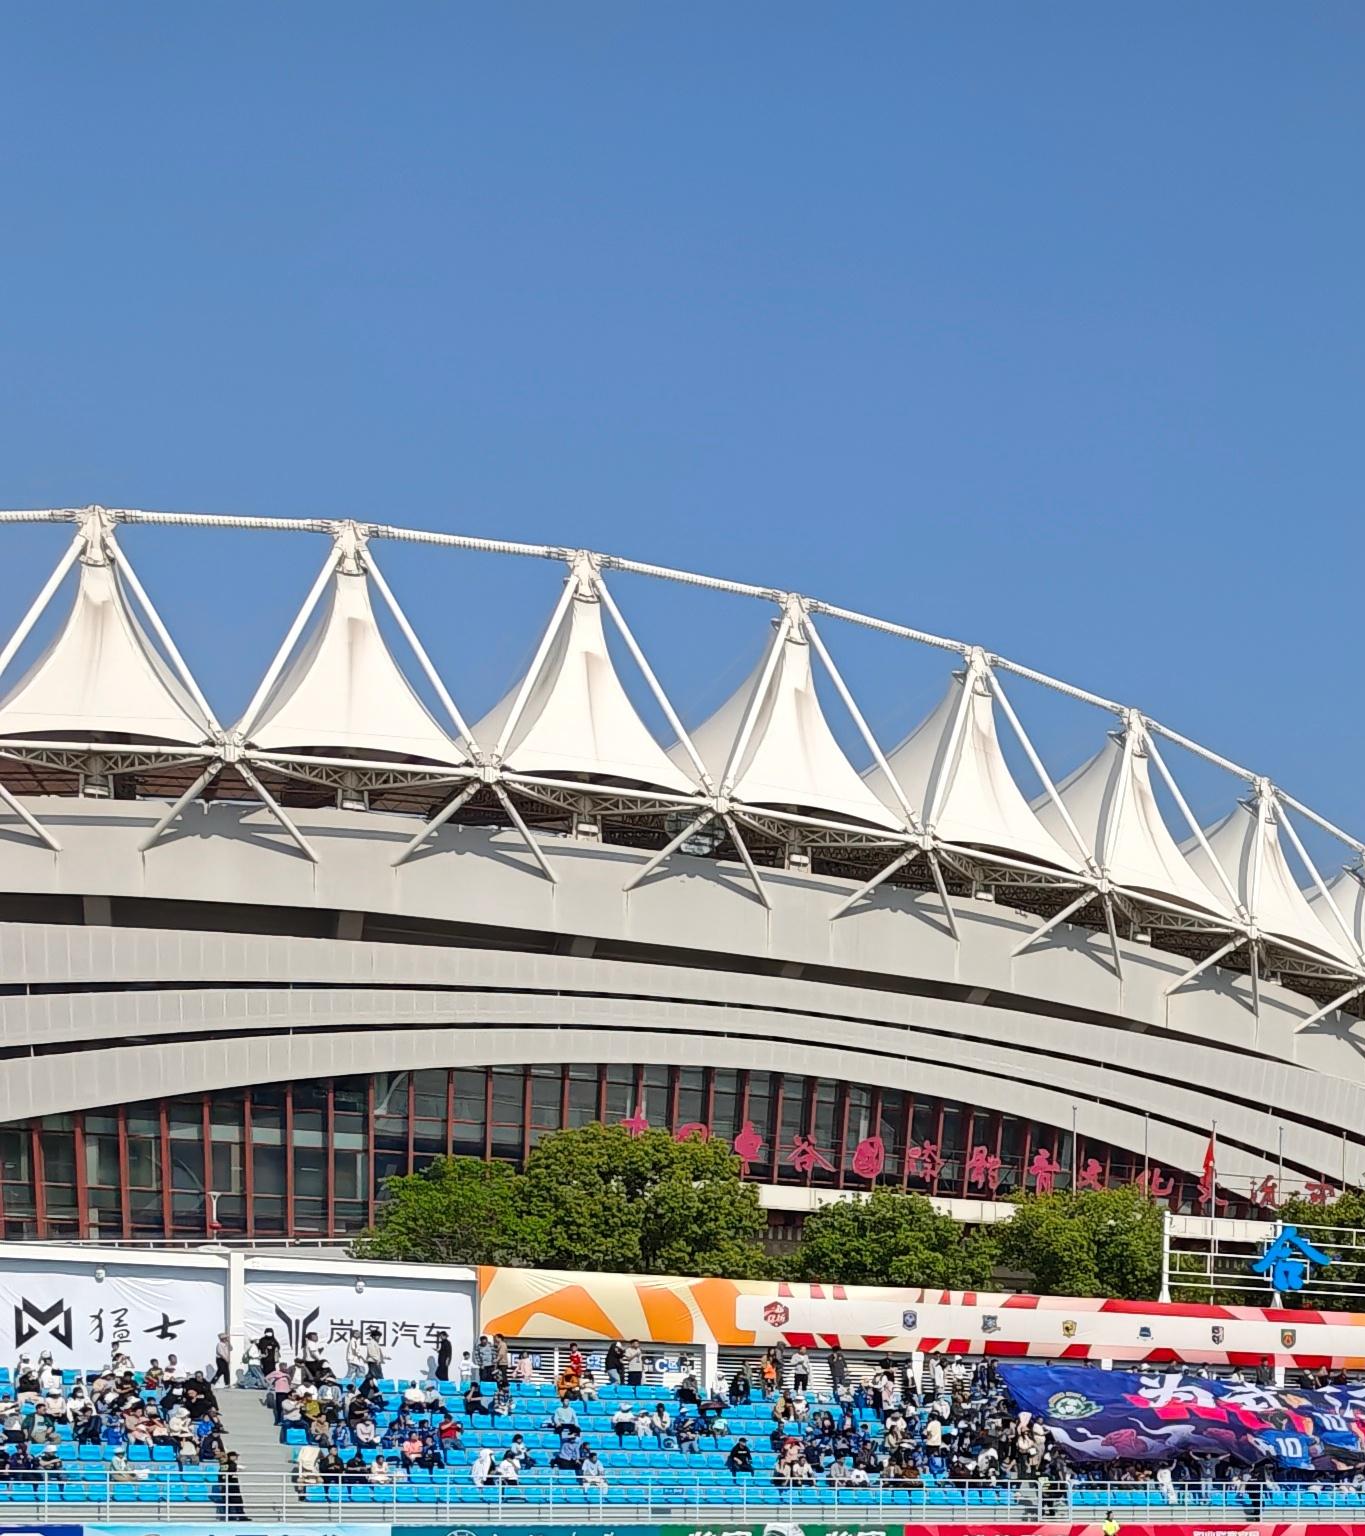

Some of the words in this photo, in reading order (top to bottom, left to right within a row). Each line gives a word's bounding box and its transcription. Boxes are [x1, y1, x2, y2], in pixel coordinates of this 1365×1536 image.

[88, 1307, 186, 1344] 猛士
[327, 1319, 451, 1349] 岚图汽车
[1275, 1437, 1300, 1458] 10
